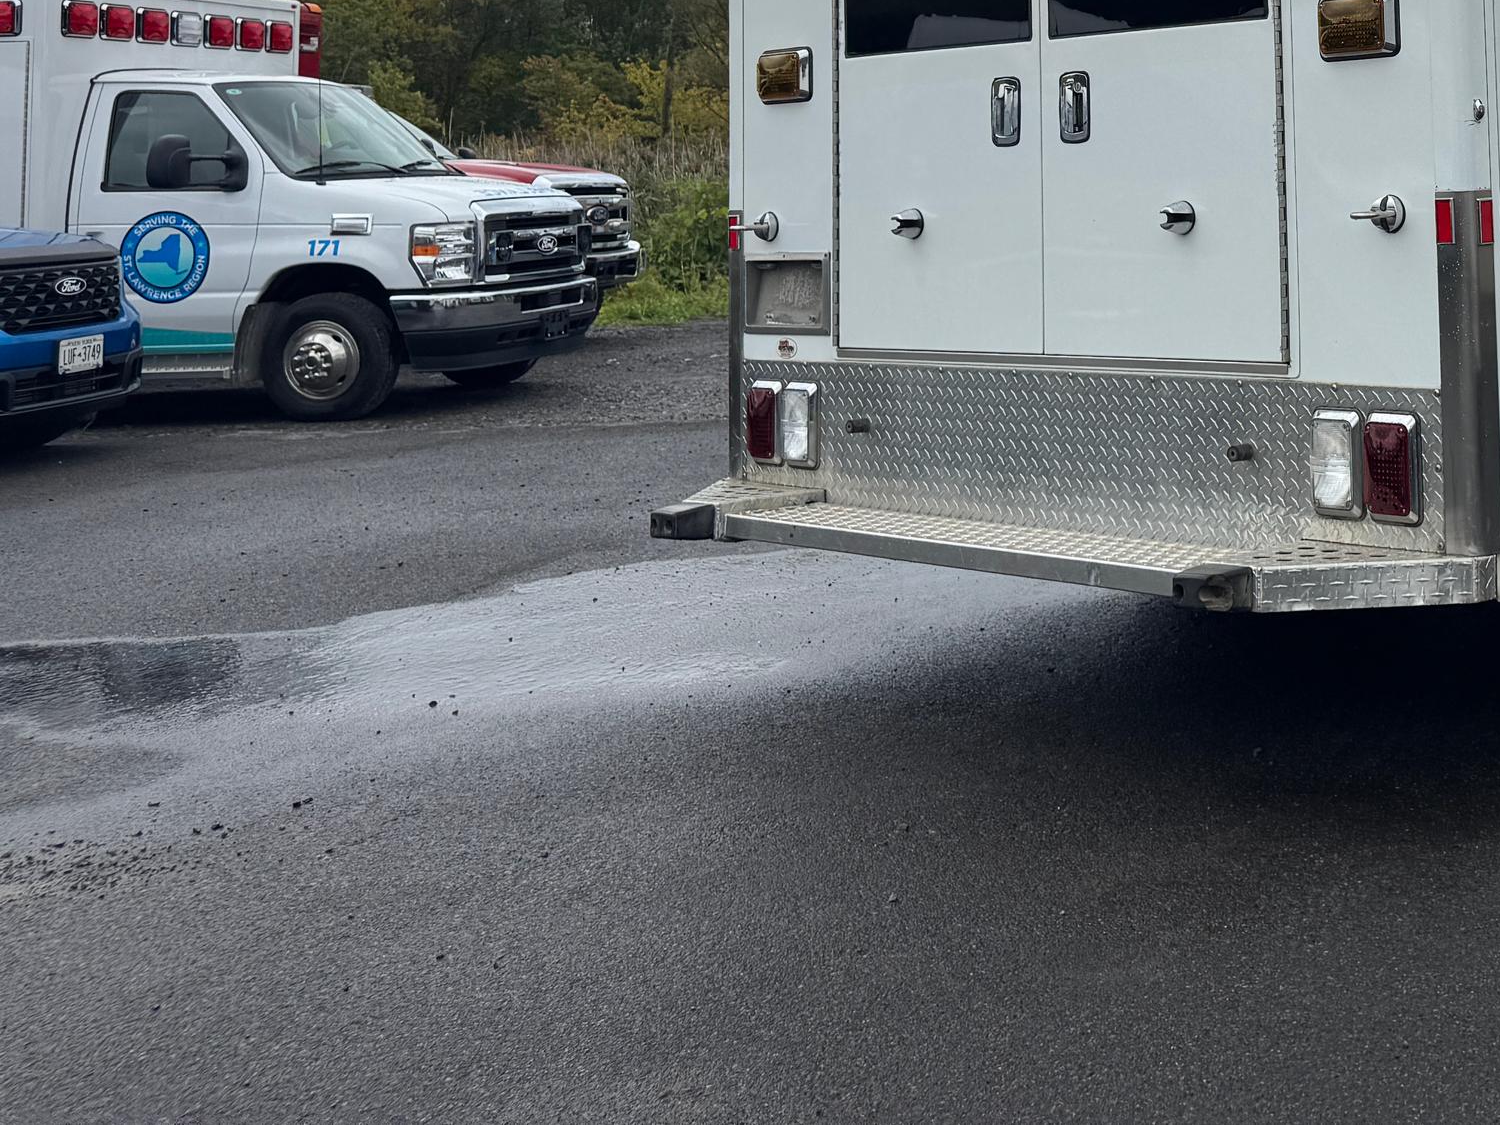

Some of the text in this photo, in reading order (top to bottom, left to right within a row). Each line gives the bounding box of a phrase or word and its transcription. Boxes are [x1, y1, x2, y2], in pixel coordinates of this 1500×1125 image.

[134, 215, 199, 236] SERVING THE
[308, 239, 340, 256] 171
[61, 279, 81, 293] Ford
[123, 255, 206, 299] ST. LAWRENCE REGION
